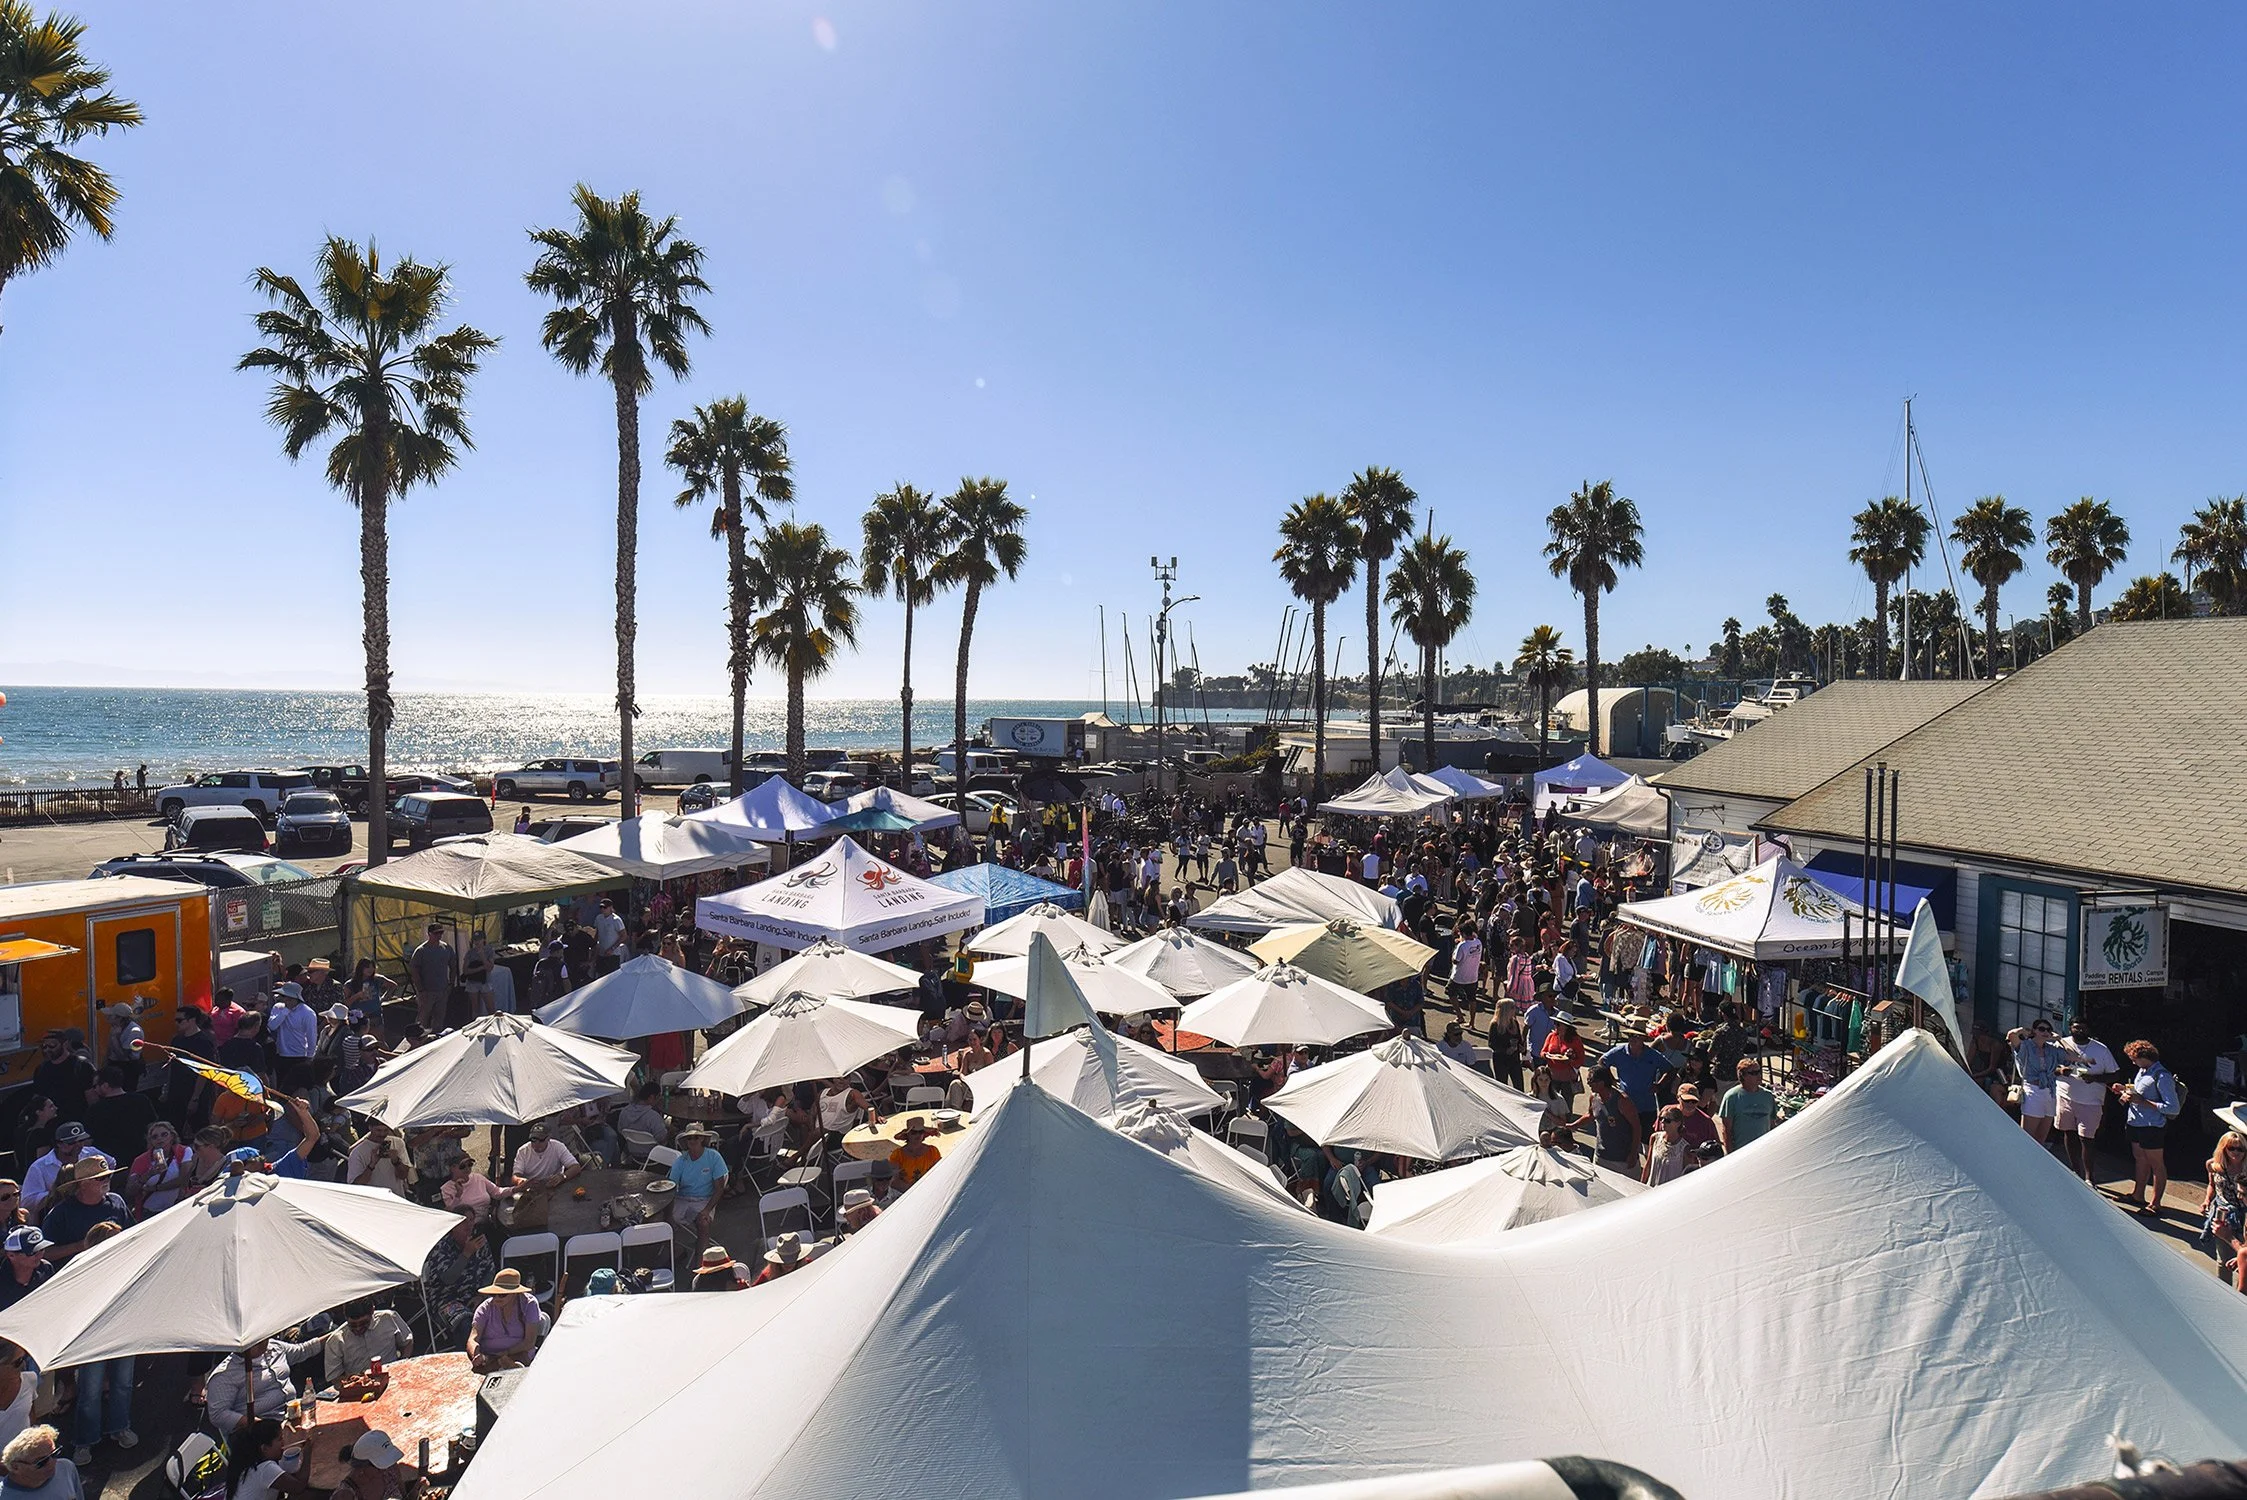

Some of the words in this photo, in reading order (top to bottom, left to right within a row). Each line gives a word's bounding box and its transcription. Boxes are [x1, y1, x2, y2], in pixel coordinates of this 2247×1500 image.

[761, 893, 810, 909] LANDING
[877, 892, 925, 908] LANDING
[709, 911, 728, 922] Santa
[729, 915, 755, 929] Barbara
[797, 930, 822, 943] Include
[858, 933, 880, 944] Santa
[880, 926, 908, 939] Barbara
[947, 909, 971, 921] Included
[1783, 943, 1828, 954] Ocean
[2108, 972, 2143, 984] RENTALS
